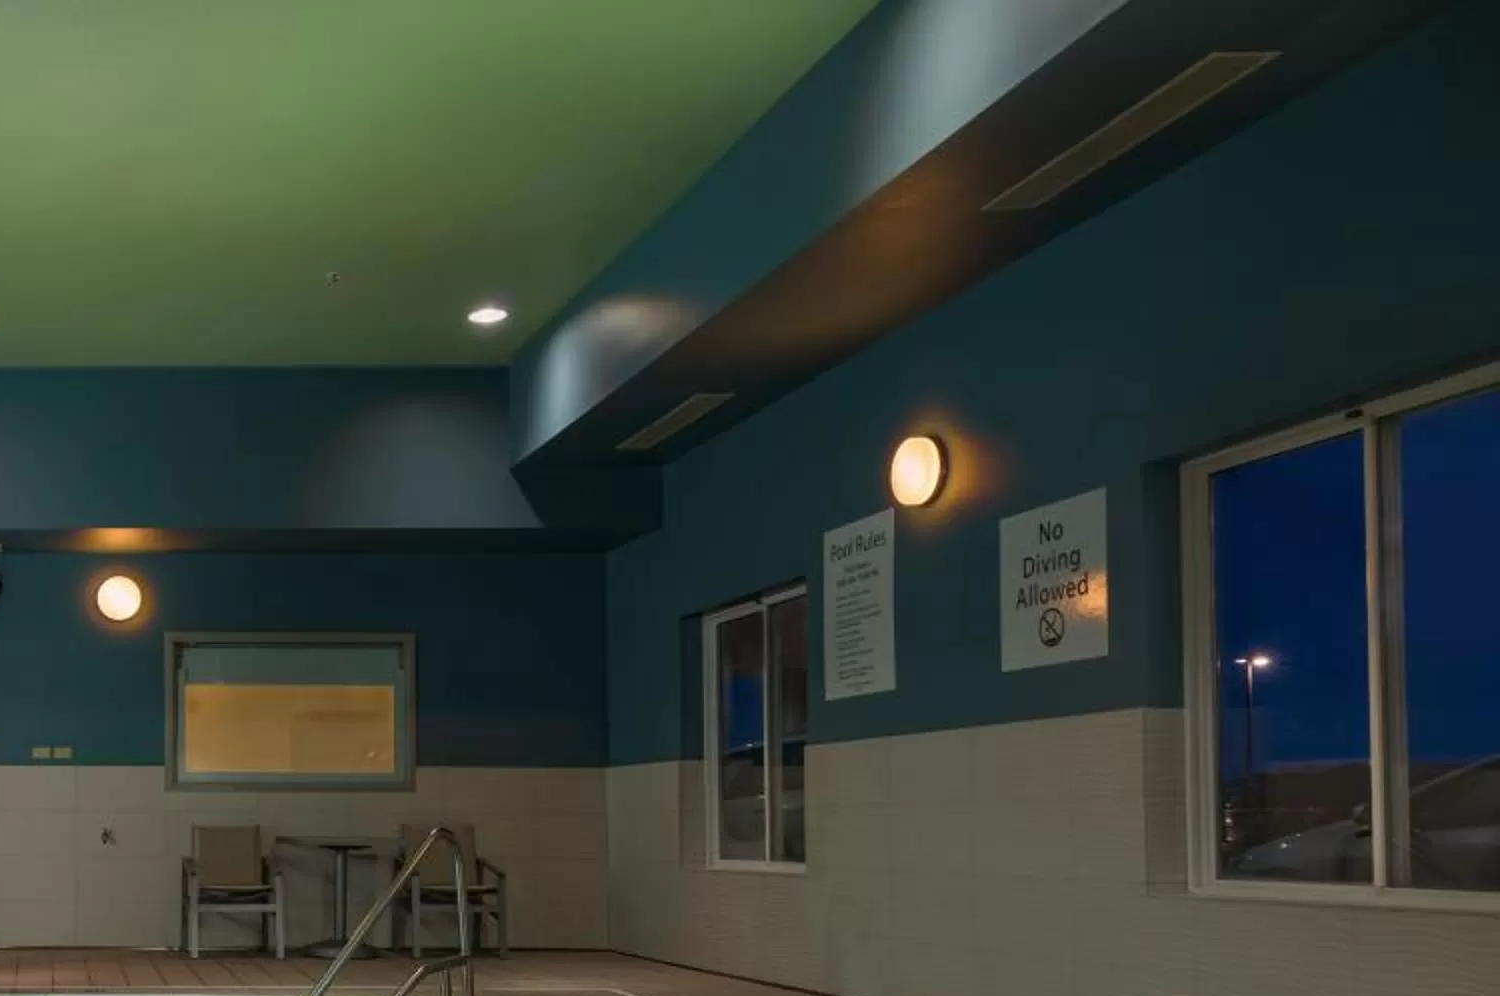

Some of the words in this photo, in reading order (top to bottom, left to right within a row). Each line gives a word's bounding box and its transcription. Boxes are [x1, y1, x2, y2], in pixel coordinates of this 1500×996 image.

[830, 537, 853, 562] Pool
[856, 530, 887, 553] Rules
[1039, 521, 1065, 544] No
[1023, 548, 1081, 579] Diving
[1016, 572, 1090, 609] Allowed
